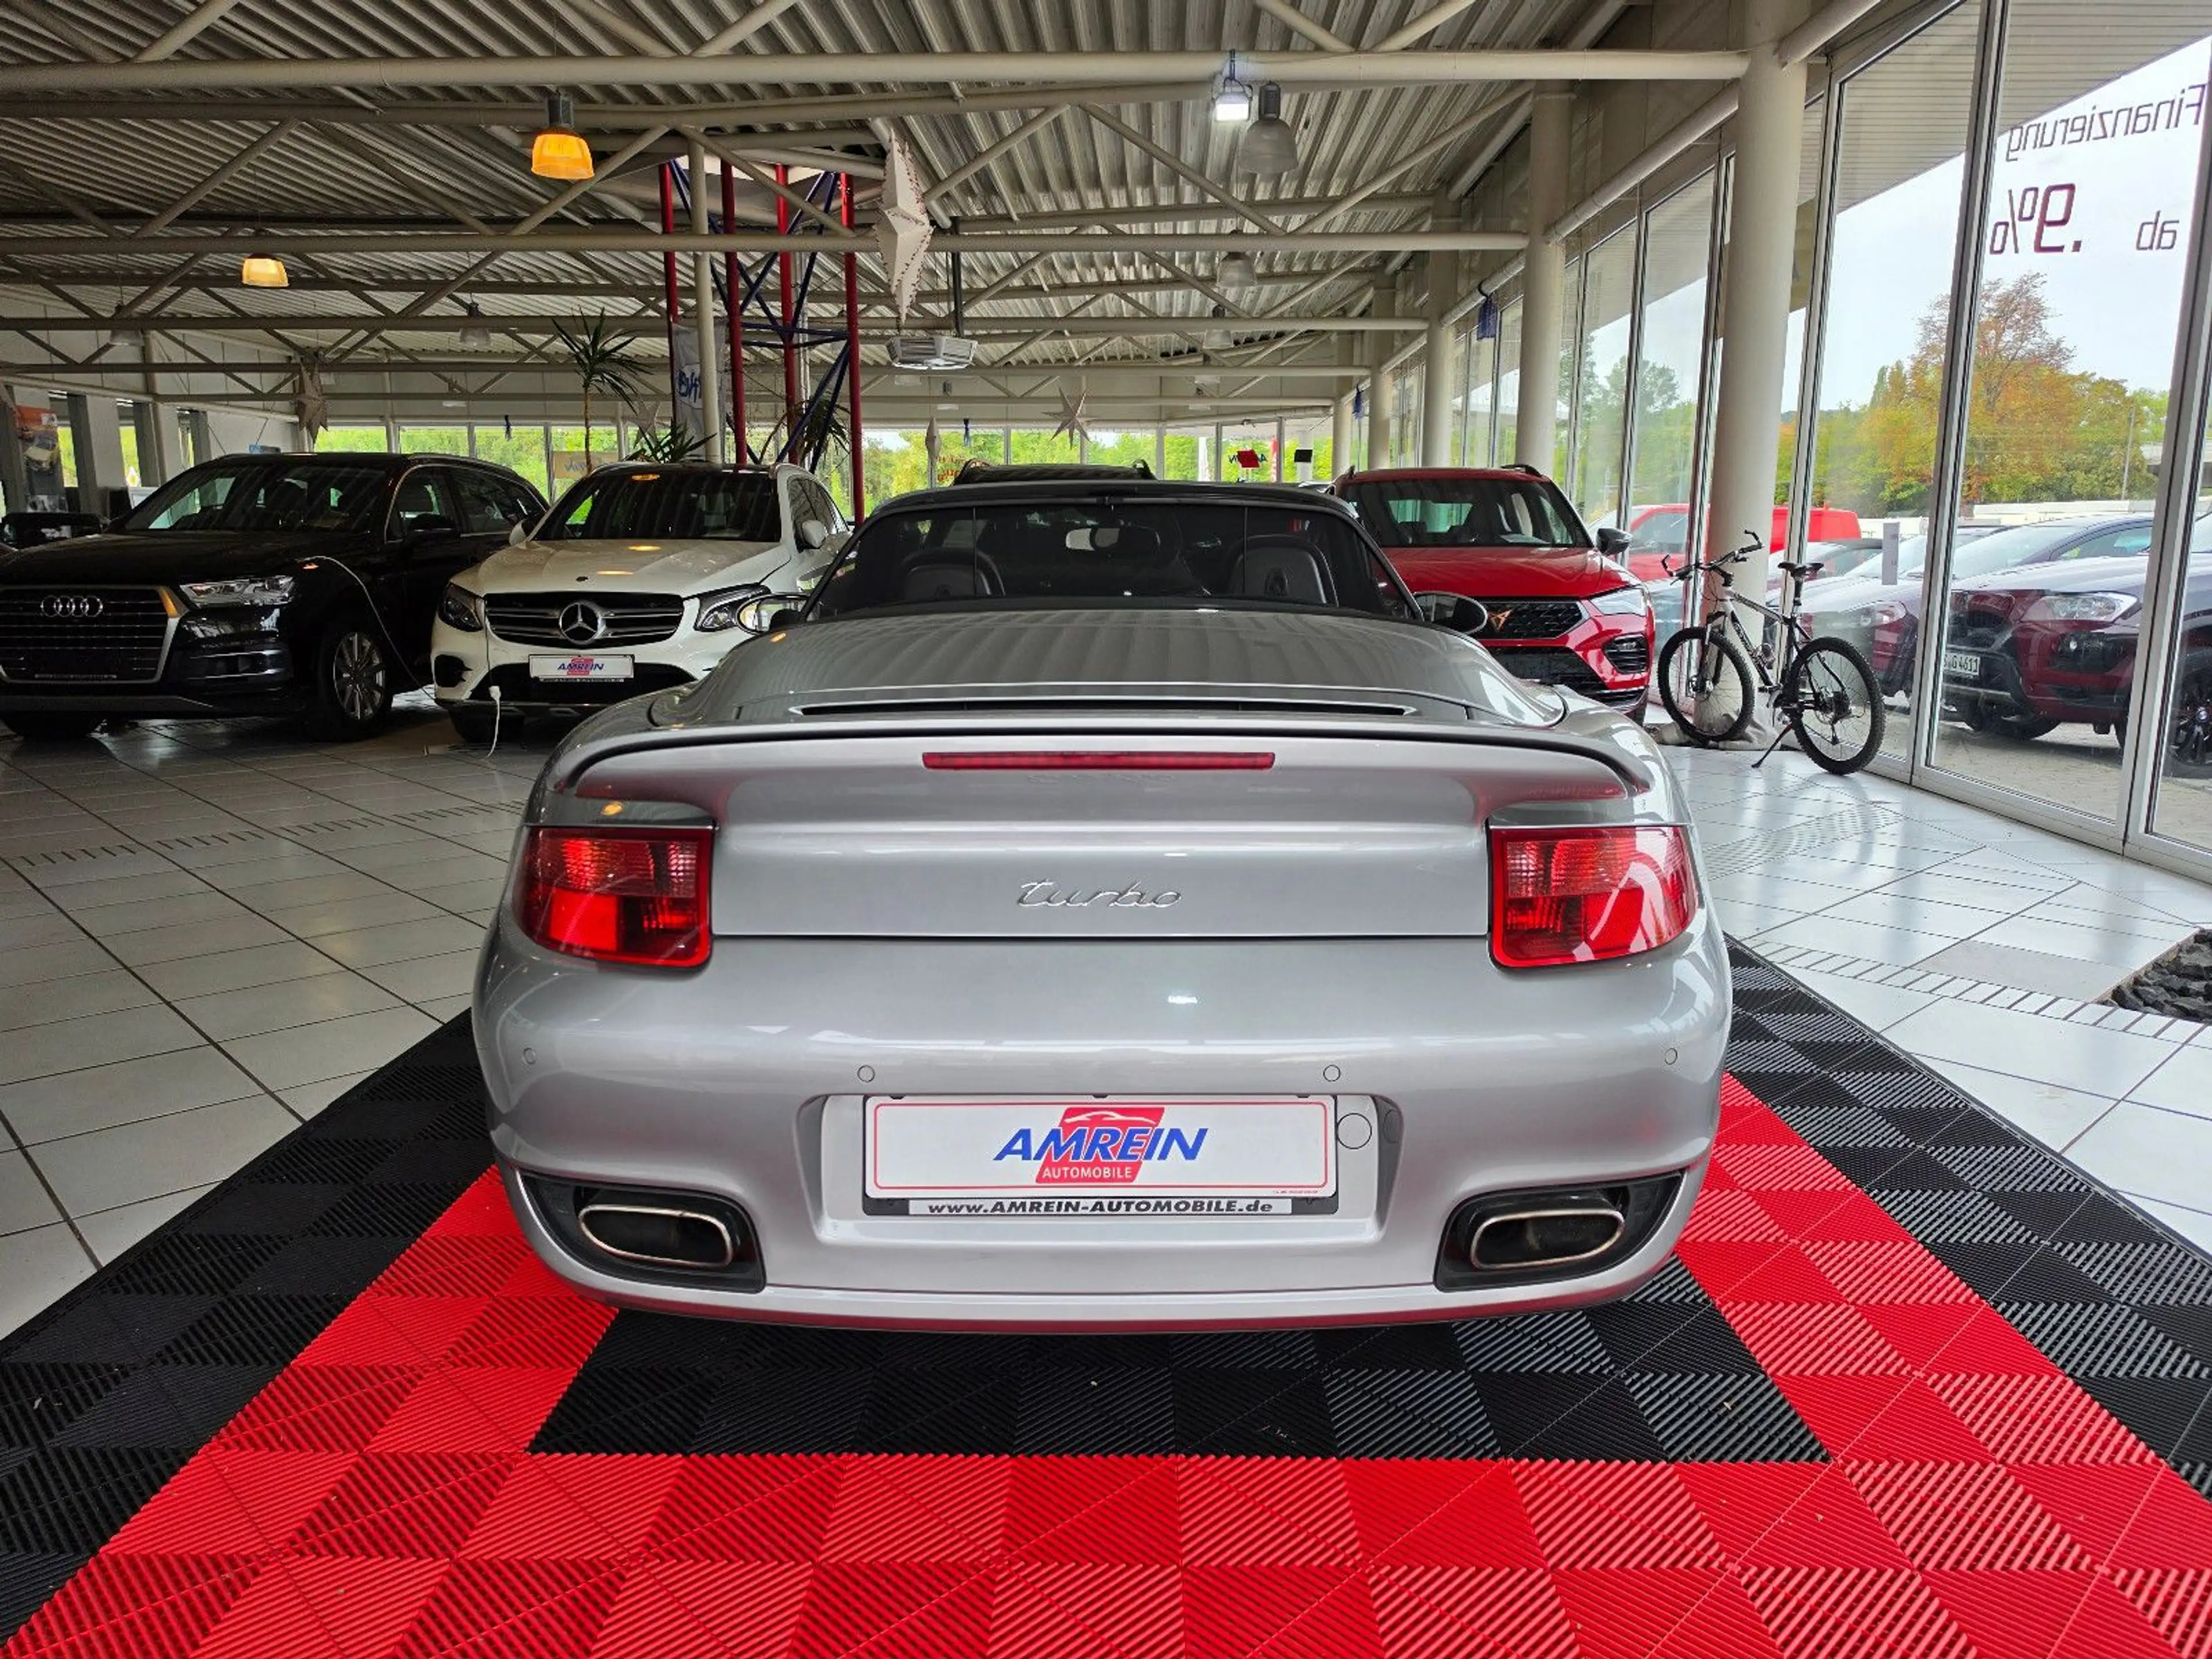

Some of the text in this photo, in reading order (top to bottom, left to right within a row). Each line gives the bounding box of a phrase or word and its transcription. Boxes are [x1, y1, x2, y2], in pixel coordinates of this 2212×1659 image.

[1017, 878, 1181, 908] turbo
[993, 1127, 1209, 1161] AMREIN
[1041, 1166, 1132, 1179] AUTOMOBILE
[927, 1199, 1273, 1214] www.AMREIN-AUTOMOBILE.de
